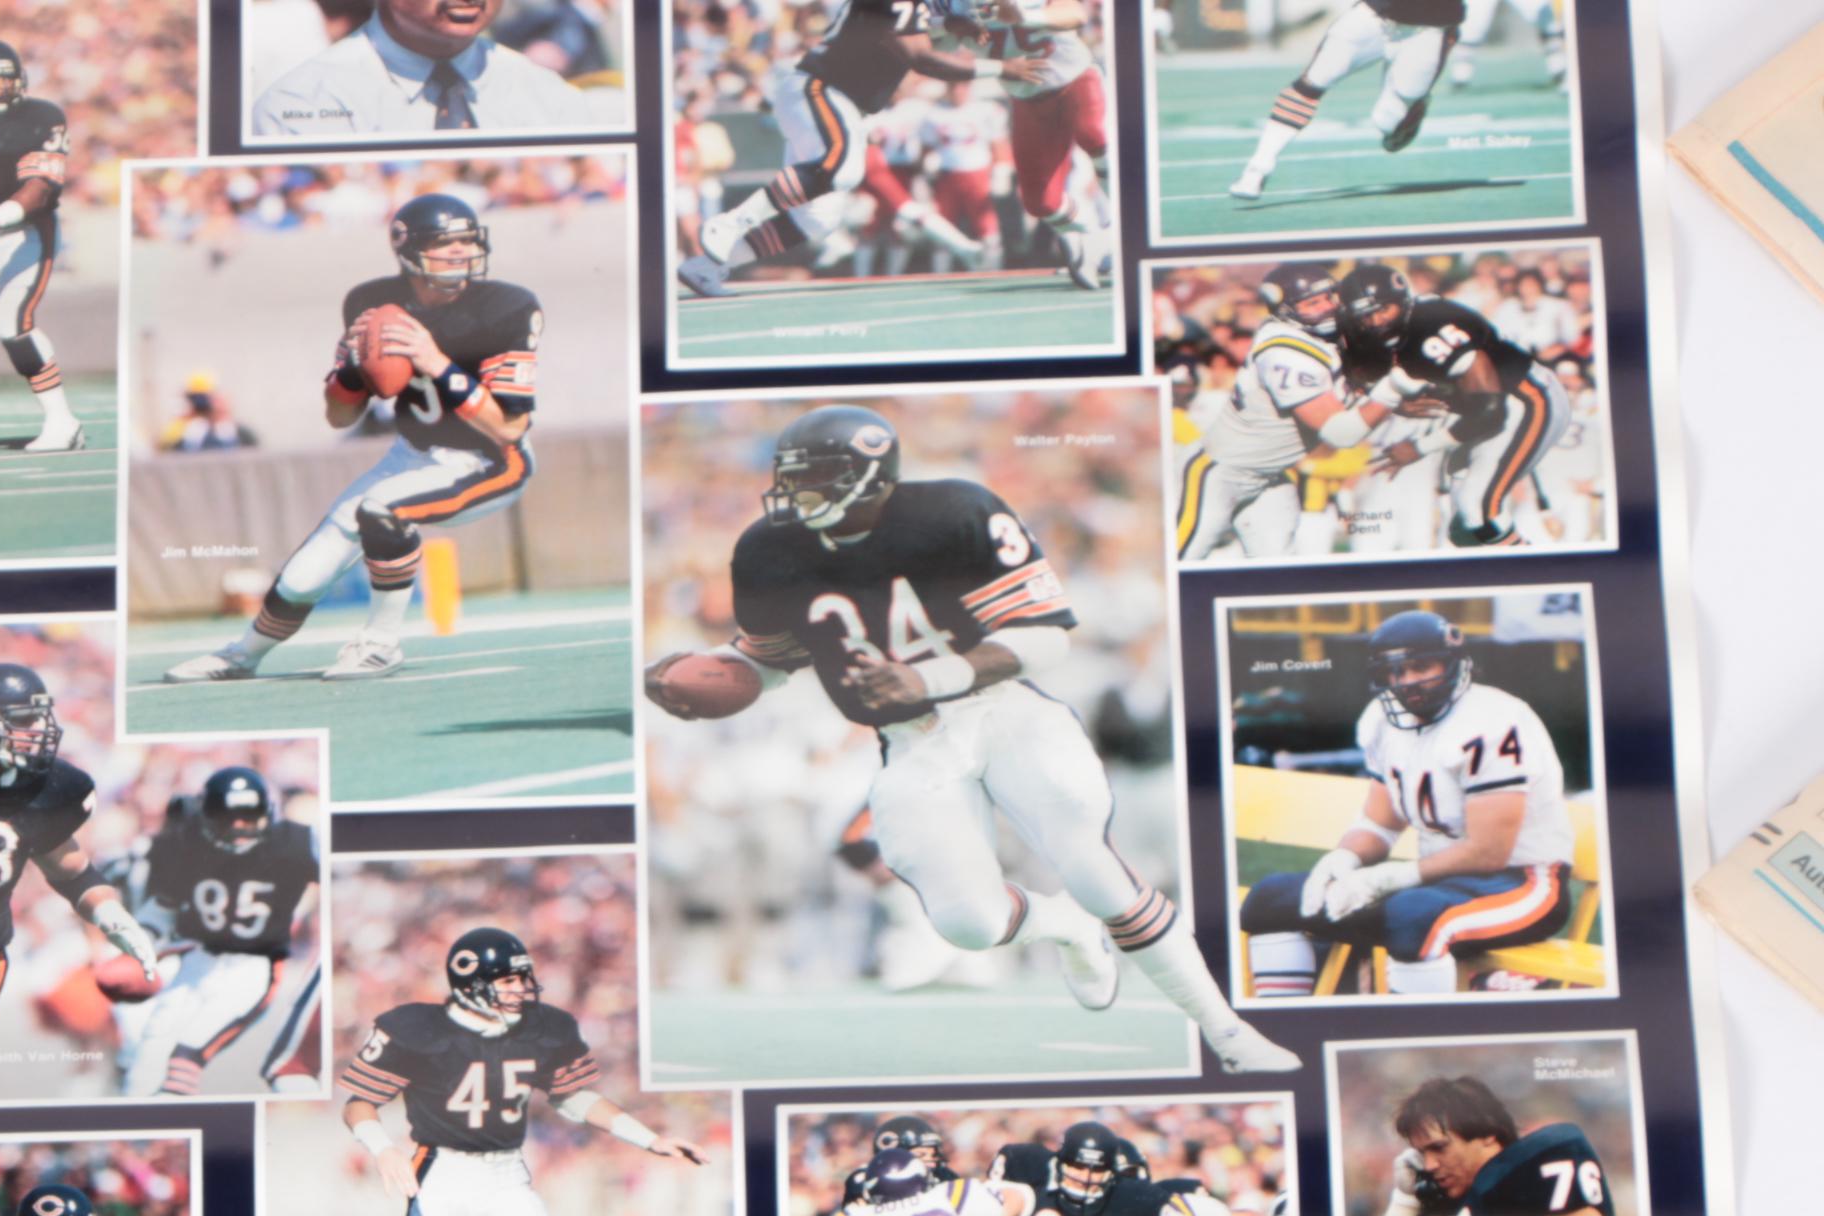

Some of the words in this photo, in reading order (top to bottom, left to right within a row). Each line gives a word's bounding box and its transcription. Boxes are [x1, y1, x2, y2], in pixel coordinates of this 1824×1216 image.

[282, 109, 314, 120] Mike
[1064, 433, 1116, 448] Payton
[1347, 523, 1381, 535] Dent
[160, 545, 187, 560] Jim
[191, 544, 259, 558] McMahon
[808, 575, 956, 663] 34
[1250, 659, 1279, 673] Jim
[1281, 657, 1333, 672] Covert
[1461, 724, 1523, 777] 74
[27, 1049, 56, 1062] Van
[60, 1048, 104, 1061] Horne
[1533, 1056, 1578, 1068] Steve
[445, 1058, 537, 1130] 45
[1539, 1159, 1604, 1211] 76
